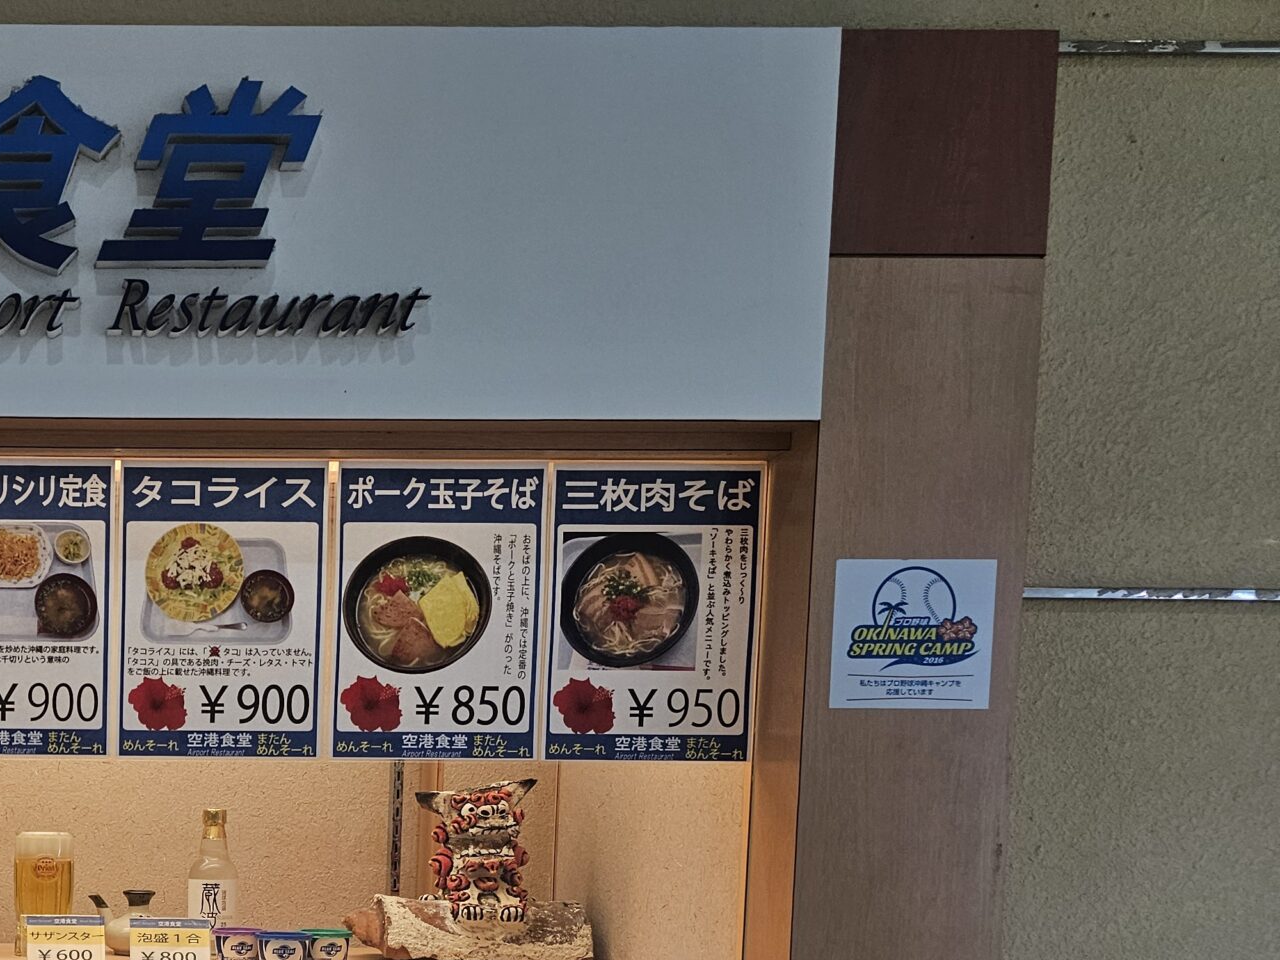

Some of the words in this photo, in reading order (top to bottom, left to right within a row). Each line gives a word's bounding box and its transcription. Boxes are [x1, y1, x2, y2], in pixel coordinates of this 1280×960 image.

[109, 278, 429, 337] Restaurant
[131, 475, 317, 508] タコライス
[347, 475, 538, 510] ポーク玉子そば
[562, 478, 755, 512] 三枚肉そば
[854, 628, 937, 640] OKINAWA
[850, 642, 916, 656] SPRING
[919, 642, 972, 655] CAMP
[199, 684, 309, 724] ¥900
[414, 685, 525, 726] ¥850
[627, 688, 740, 728] ¥950
[47, 731, 81, 742] またん
[187, 732, 252, 748] 空港食堂
[257, 734, 291, 744] またん
[402, 734, 467, 749] 空港食堂
[473, 735, 507, 746] またん
[686, 737, 720, 748] またん
[47, 742, 103, 754] めんそーれ
[123, 739, 179, 751] めんそーれ
[336, 741, 393, 752] めんそーれ
[550, 743, 606, 755] めんそーれ
[615, 736, 680, 751] 空港食堂
[257, 744, 314, 756] めんそーれ
[472, 746, 530, 757] めんそーれ
[685, 748, 744, 760] めんそーれ
[30, 931, 104, 940] サザンスター
[137, 932, 202, 944] 泡盛1合
